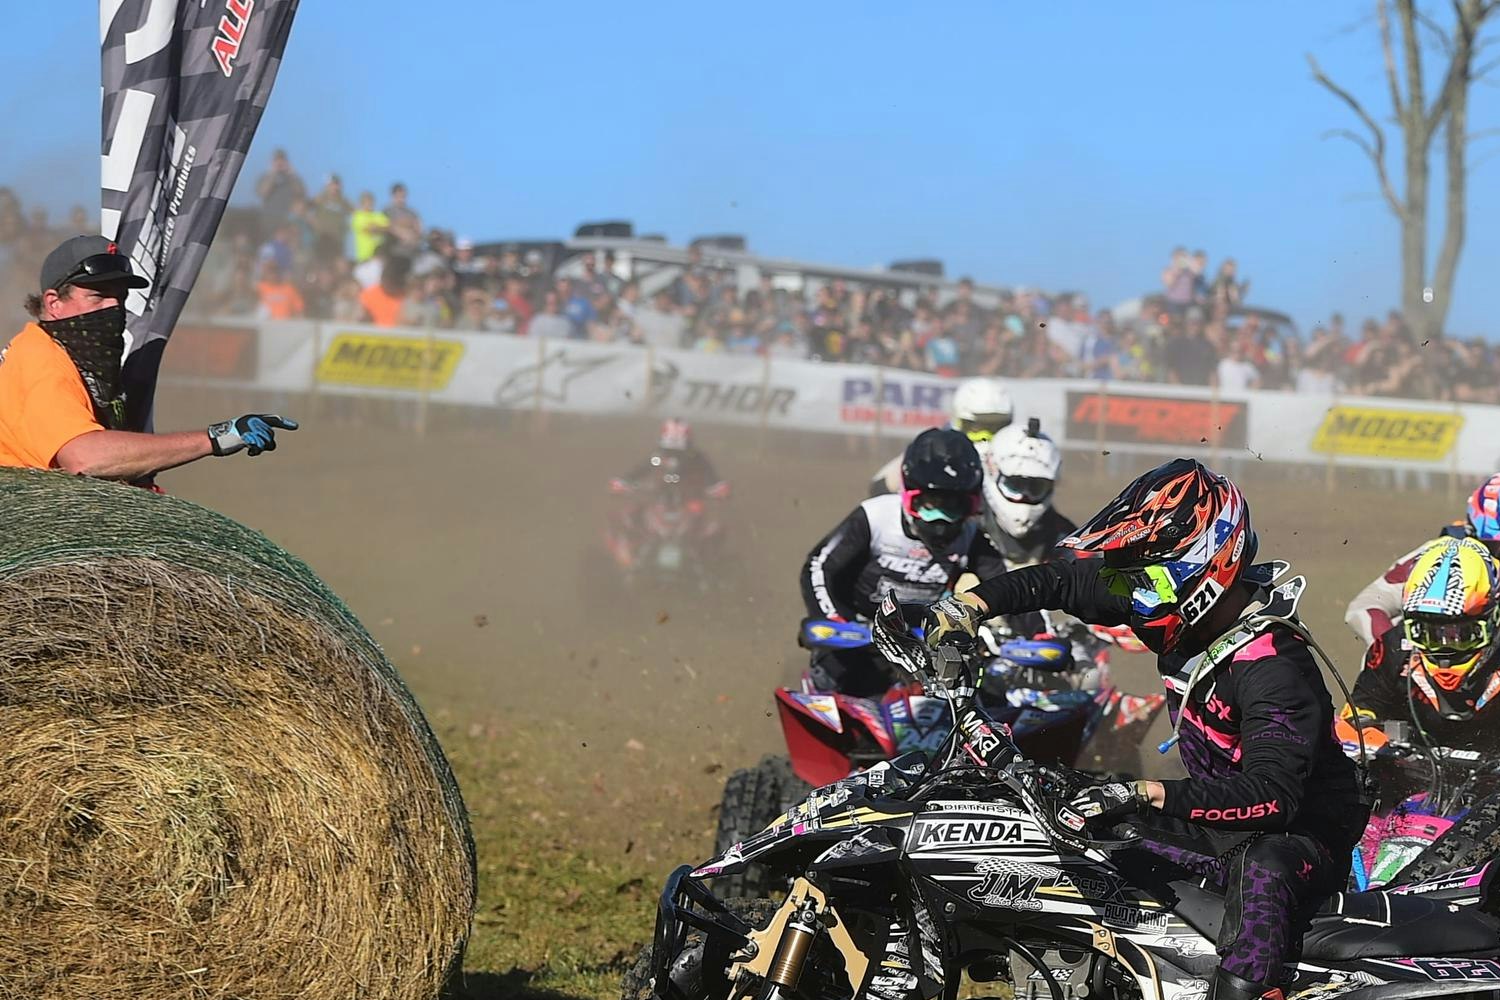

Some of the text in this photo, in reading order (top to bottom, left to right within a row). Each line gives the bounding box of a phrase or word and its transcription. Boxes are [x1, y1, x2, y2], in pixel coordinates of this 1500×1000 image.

[170, 145, 197, 215] Products
[684, 380, 797, 416] THOR
[841, 378, 960, 408] PART
[1326, 412, 1451, 444] MOOSE
[1183, 582, 1217, 623] 621
[1251, 731, 1311, 746] FOCUSX
[1190, 800, 1280, 821] FOCUSX
[921, 822, 1024, 844] KENDA
[967, 871, 1042, 902] JM
[1129, 909, 1168, 928] RACING
